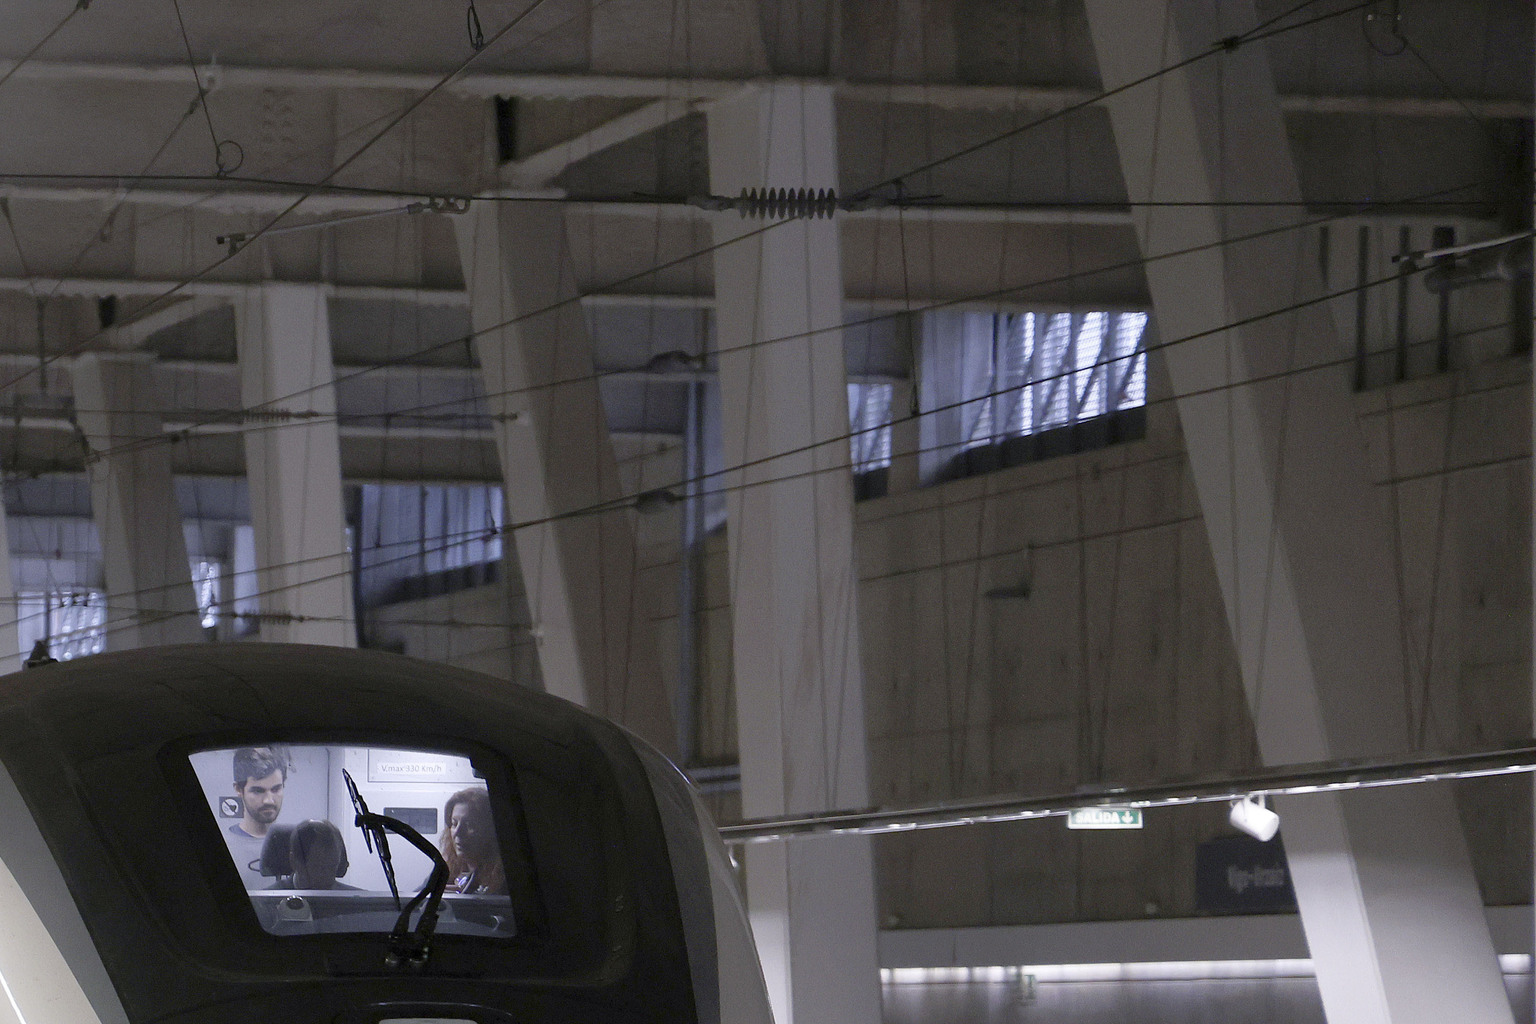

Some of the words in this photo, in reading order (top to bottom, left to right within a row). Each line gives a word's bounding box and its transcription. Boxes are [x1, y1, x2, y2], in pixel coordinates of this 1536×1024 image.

[405, 764, 420, 773] 330
[421, 765, 442, 775] Km/h
[1075, 811, 1121, 824] SALIDA
